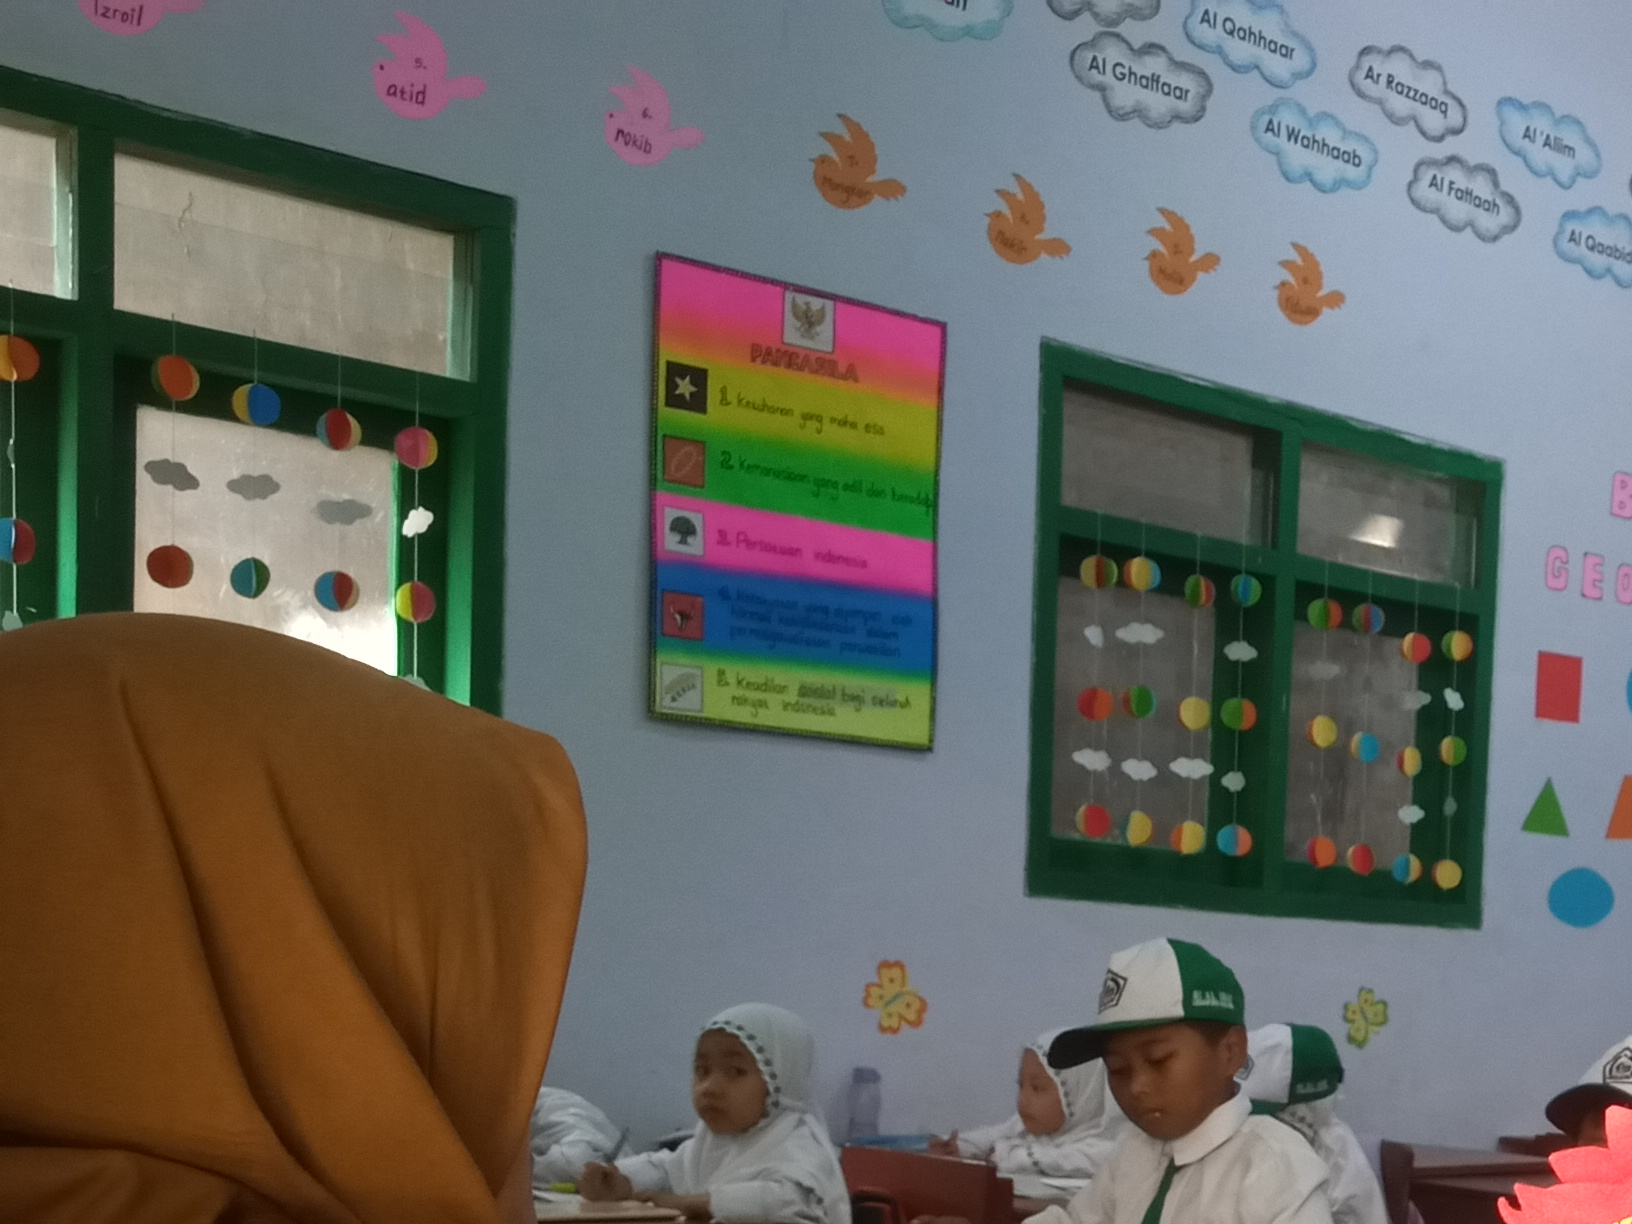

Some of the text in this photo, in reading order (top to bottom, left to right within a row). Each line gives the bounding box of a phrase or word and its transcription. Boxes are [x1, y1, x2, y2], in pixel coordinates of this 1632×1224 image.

[1199, 8, 1296, 60] Al Qahhaar
[386, 82, 427, 107] atid
[1088, 54, 1190, 103] Al Ghaffaar
[1364, 65, 1449, 119] Ar Razzaaq
[1263, 117, 1362, 168] Al Wahhaab
[1522, 125, 1537, 144] Al
[1428, 174, 1500, 216] Al Fattaah
[1567, 229, 1582, 246] Al
